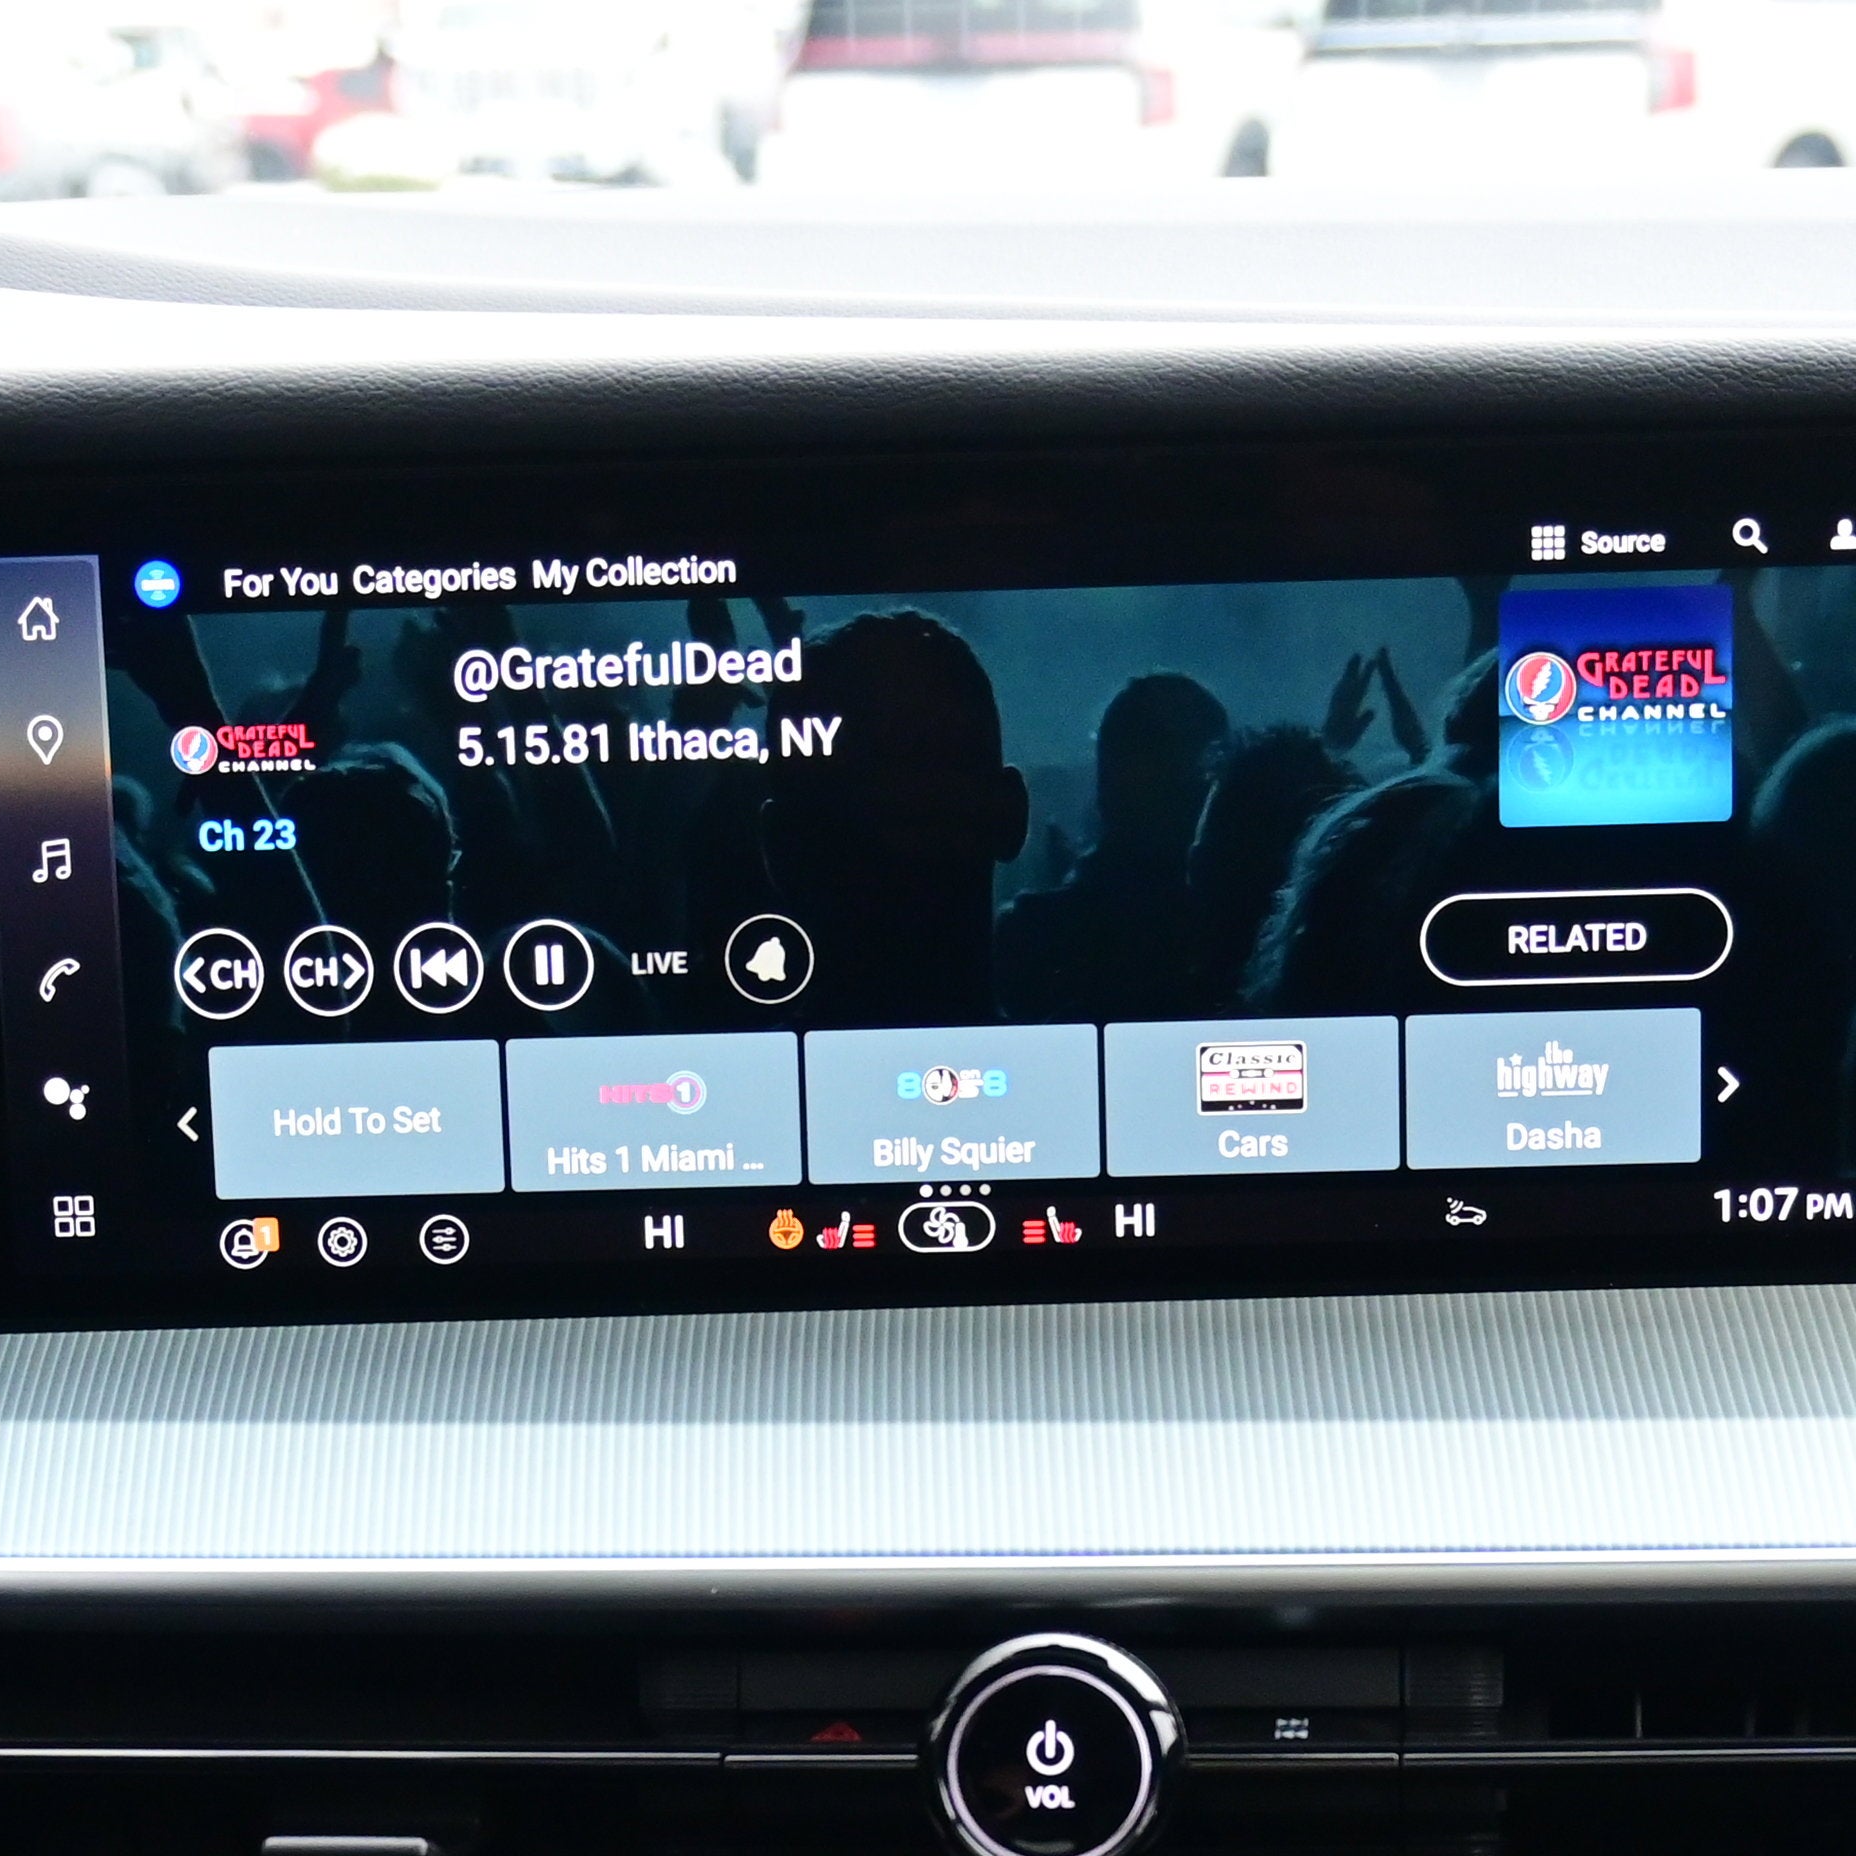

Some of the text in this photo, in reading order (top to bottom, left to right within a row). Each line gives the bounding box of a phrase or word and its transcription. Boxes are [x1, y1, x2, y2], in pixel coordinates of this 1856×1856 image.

[1581, 531, 1666, 555] Source
[224, 567, 338, 598] For You
[352, 562, 517, 599] Categories
[532, 555, 737, 594] My Collection
[454, 637, 803, 702] @GratefulDead
[1577, 647, 1727, 688] GRATEFUL
[1609, 672, 1701, 700] DEAD
[1577, 703, 1727, 722] CHANNEL
[216, 723, 316, 750] GRATEFUL
[237, 740, 298, 759] DEAD
[457, 716, 843, 767] 5.15.81 Ithaca, NY
[218, 759, 317, 774] CHANNEL
[198, 818, 297, 851] Ch 23
[1507, 923, 1648, 954] RELATED
[631, 950, 689, 976] LIVE
[1208, 1051, 1296, 1067] Classic
[1496, 1041, 1610, 1097] the highway
[1209, 1081, 1297, 1096] REWIND
[273, 1105, 442, 1137] Hold To Set
[1506, 1120, 1602, 1151] Dasha
[873, 1135, 1037, 1173] Billy Squier
[1218, 1129, 1289, 1158] Cars
[547, 1146, 607, 1176] Hits
[614, 1146, 631, 1173] 1
[641, 1143, 736, 1173] Miami
[1713, 1186, 1854, 1223] 1:07 PM
[259, 1225, 272, 1246] 1
[644, 1215, 684, 1249] HI
[1114, 1203, 1156, 1238] HI
[1024, 1784, 1076, 1811] VOL
